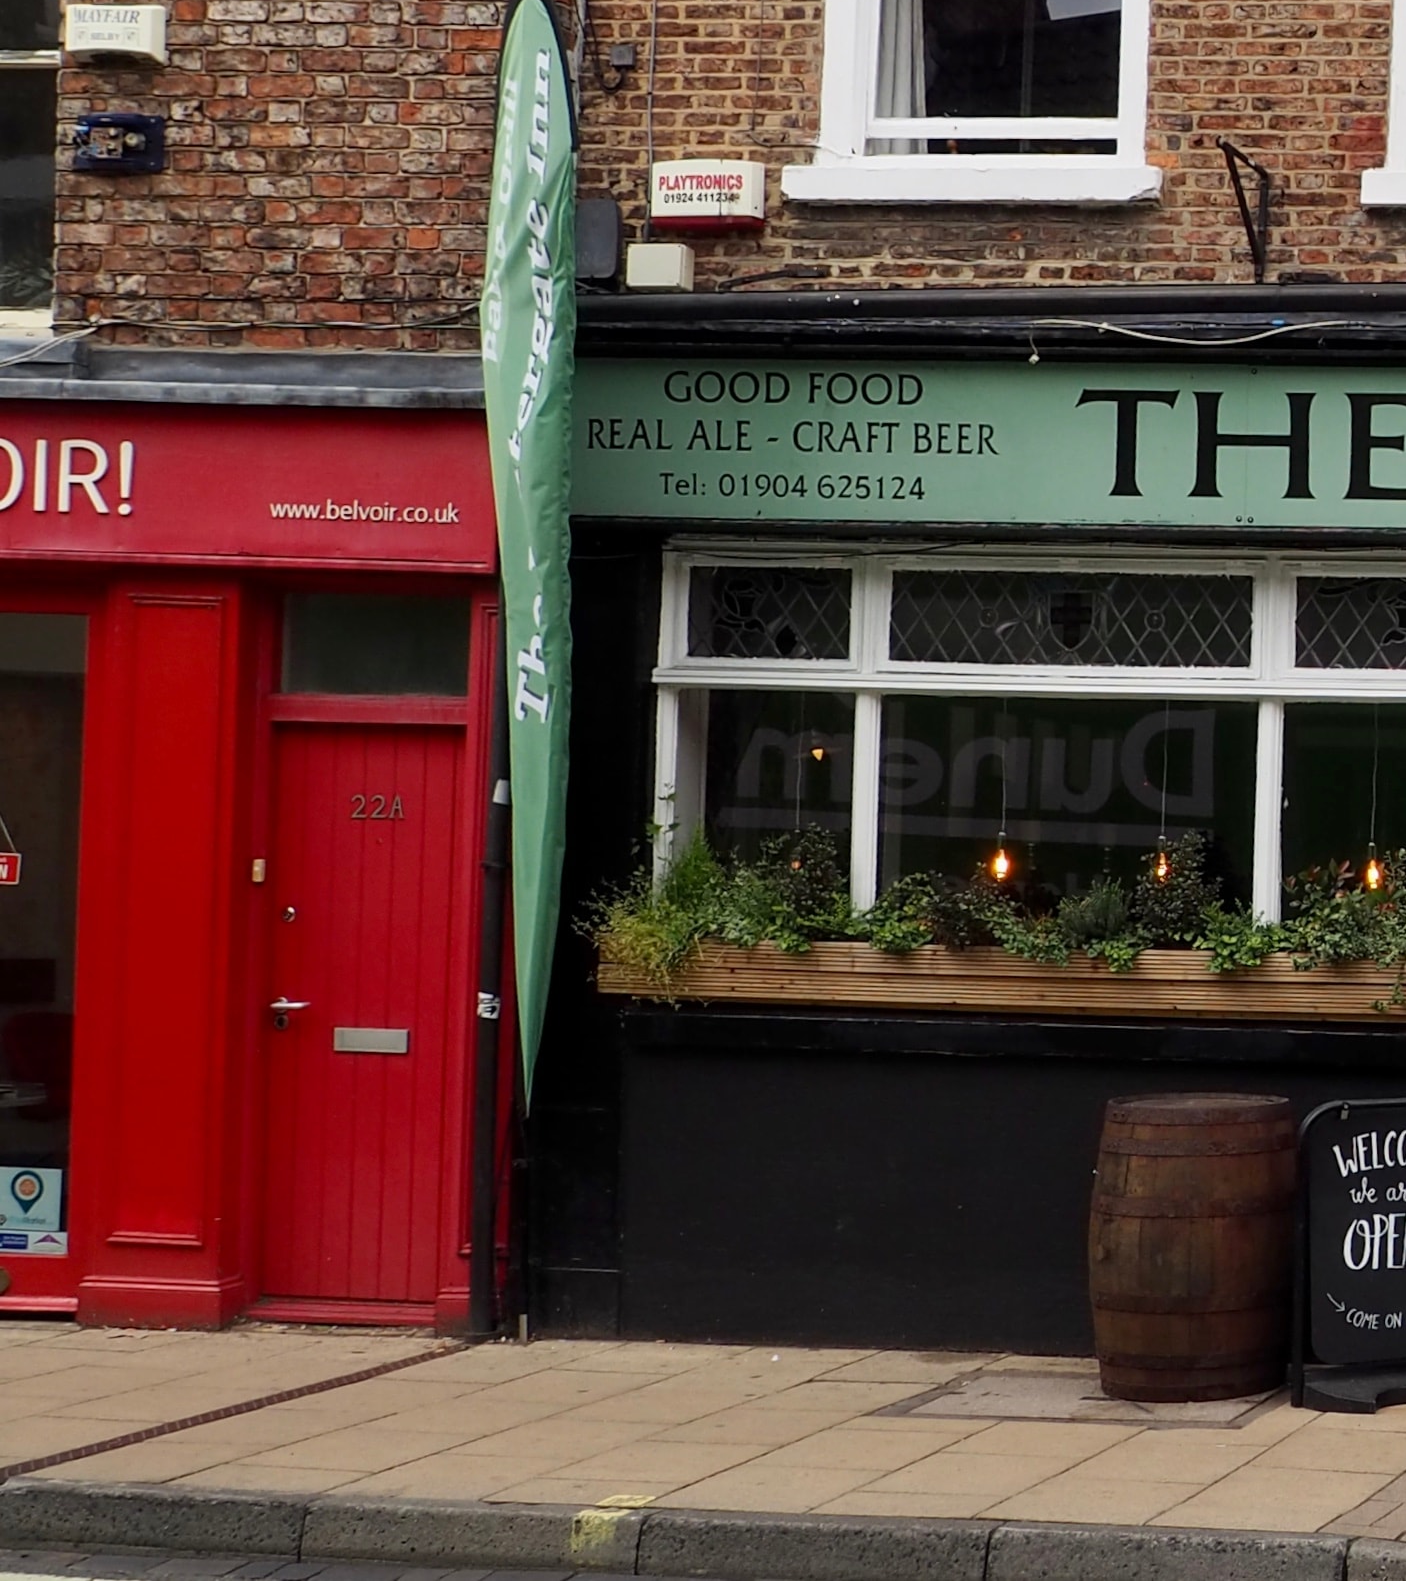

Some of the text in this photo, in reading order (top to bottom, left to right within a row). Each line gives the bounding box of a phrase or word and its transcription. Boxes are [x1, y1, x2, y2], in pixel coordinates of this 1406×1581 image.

[73, 6, 141, 25] MAYFAIR
[526, 49, 552, 184] Inn
[659, 175, 743, 191] PLAYTRONICS
[664, 193, 694, 204] 01924
[483, 278, 503, 362] Bar
[499, 78, 519, 205] Grill
[508, 198, 554, 464] tergate
[664, 370, 924, 406] GOOD FOOD
[587, 418, 673, 451] REAL
[687, 420, 753, 452] ALE
[792, 421, 900, 454] CRAFT
[914, 423, 1000, 456] BEER
[659, 473, 926, 501] Tel: 01904 625124
[270, 500, 460, 524] www.belvoir.co.uk
[350, 794, 405, 819] 22A
[1349, 1176, 1378, 1204] we
[1346, 1308, 1380, 1330] COME
[1385, 1312, 1403, 1329] ON
